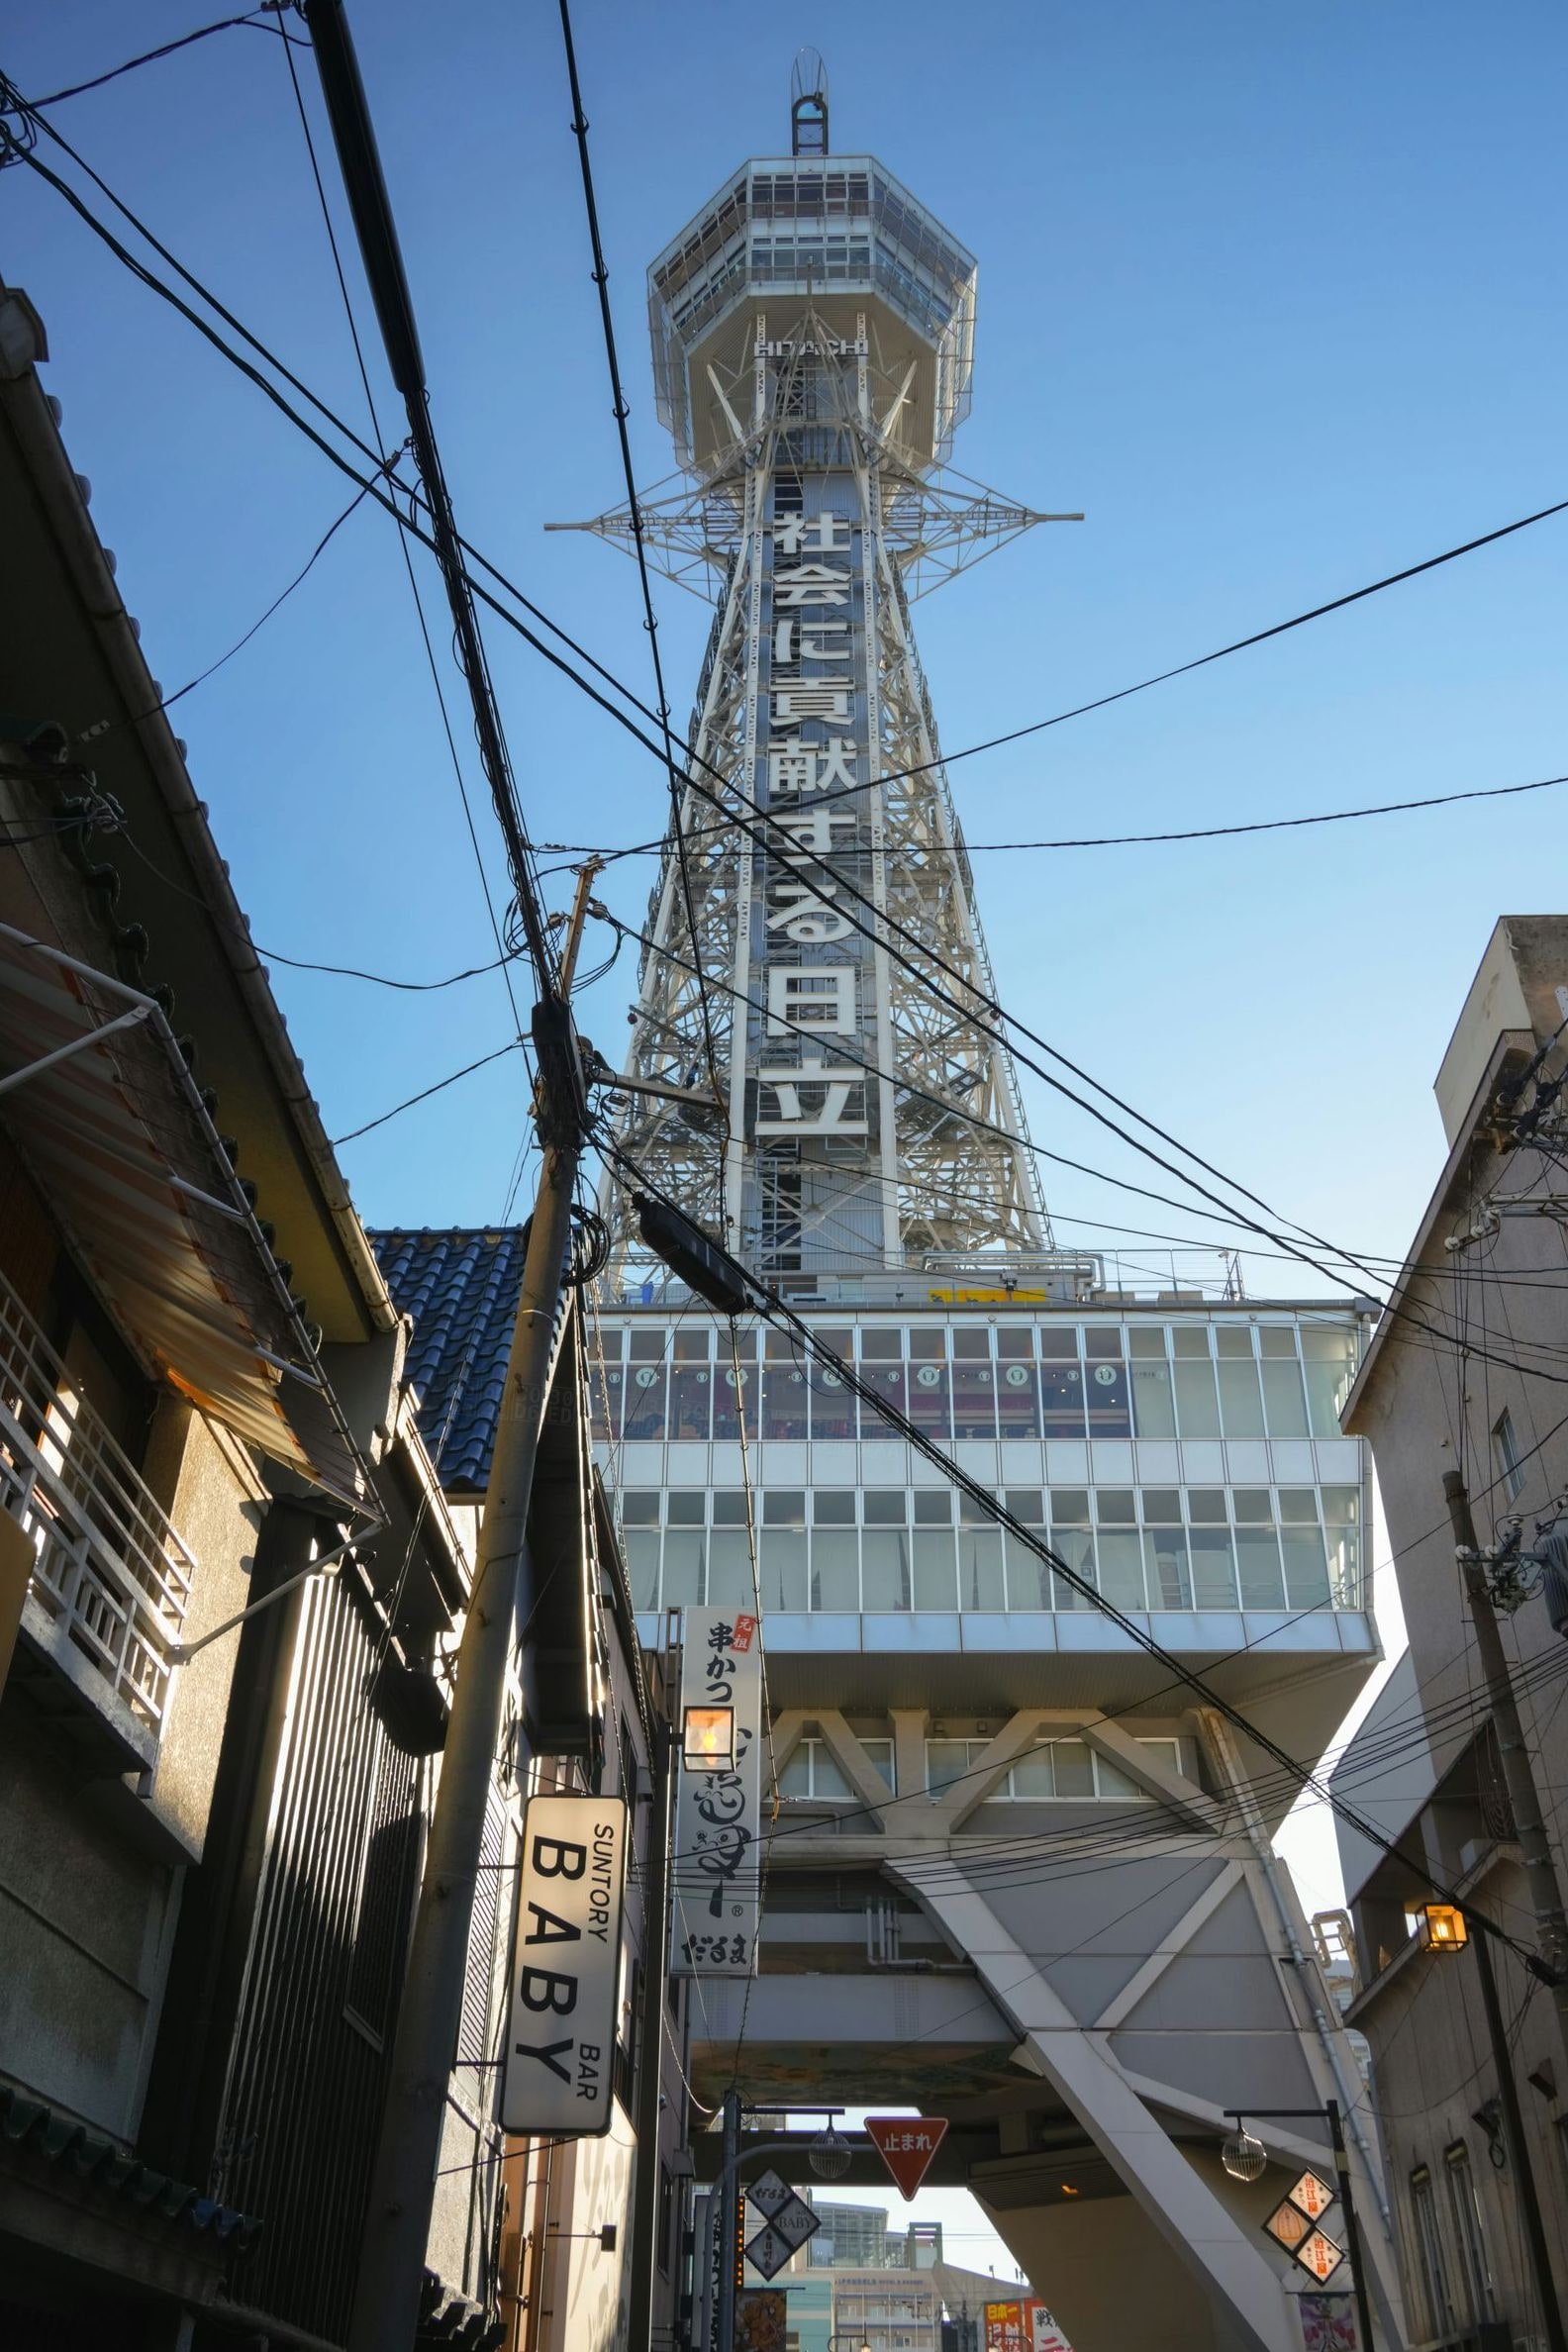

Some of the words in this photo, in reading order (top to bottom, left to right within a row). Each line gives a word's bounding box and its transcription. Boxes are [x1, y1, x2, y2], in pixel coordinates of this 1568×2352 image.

[755, 511, 868, 1135] 社会に貢献する日立
[705, 1621, 736, 1703] 串かつ
[734, 1617, 752, 1649] 元祖
[588, 1823, 614, 1944] SUNTORY
[516, 1835, 587, 2085] BABY
[681, 1933, 746, 1965] だるま
[576, 2042, 601, 2102] BAR
[883, 2132, 933, 2152] 止まれ
